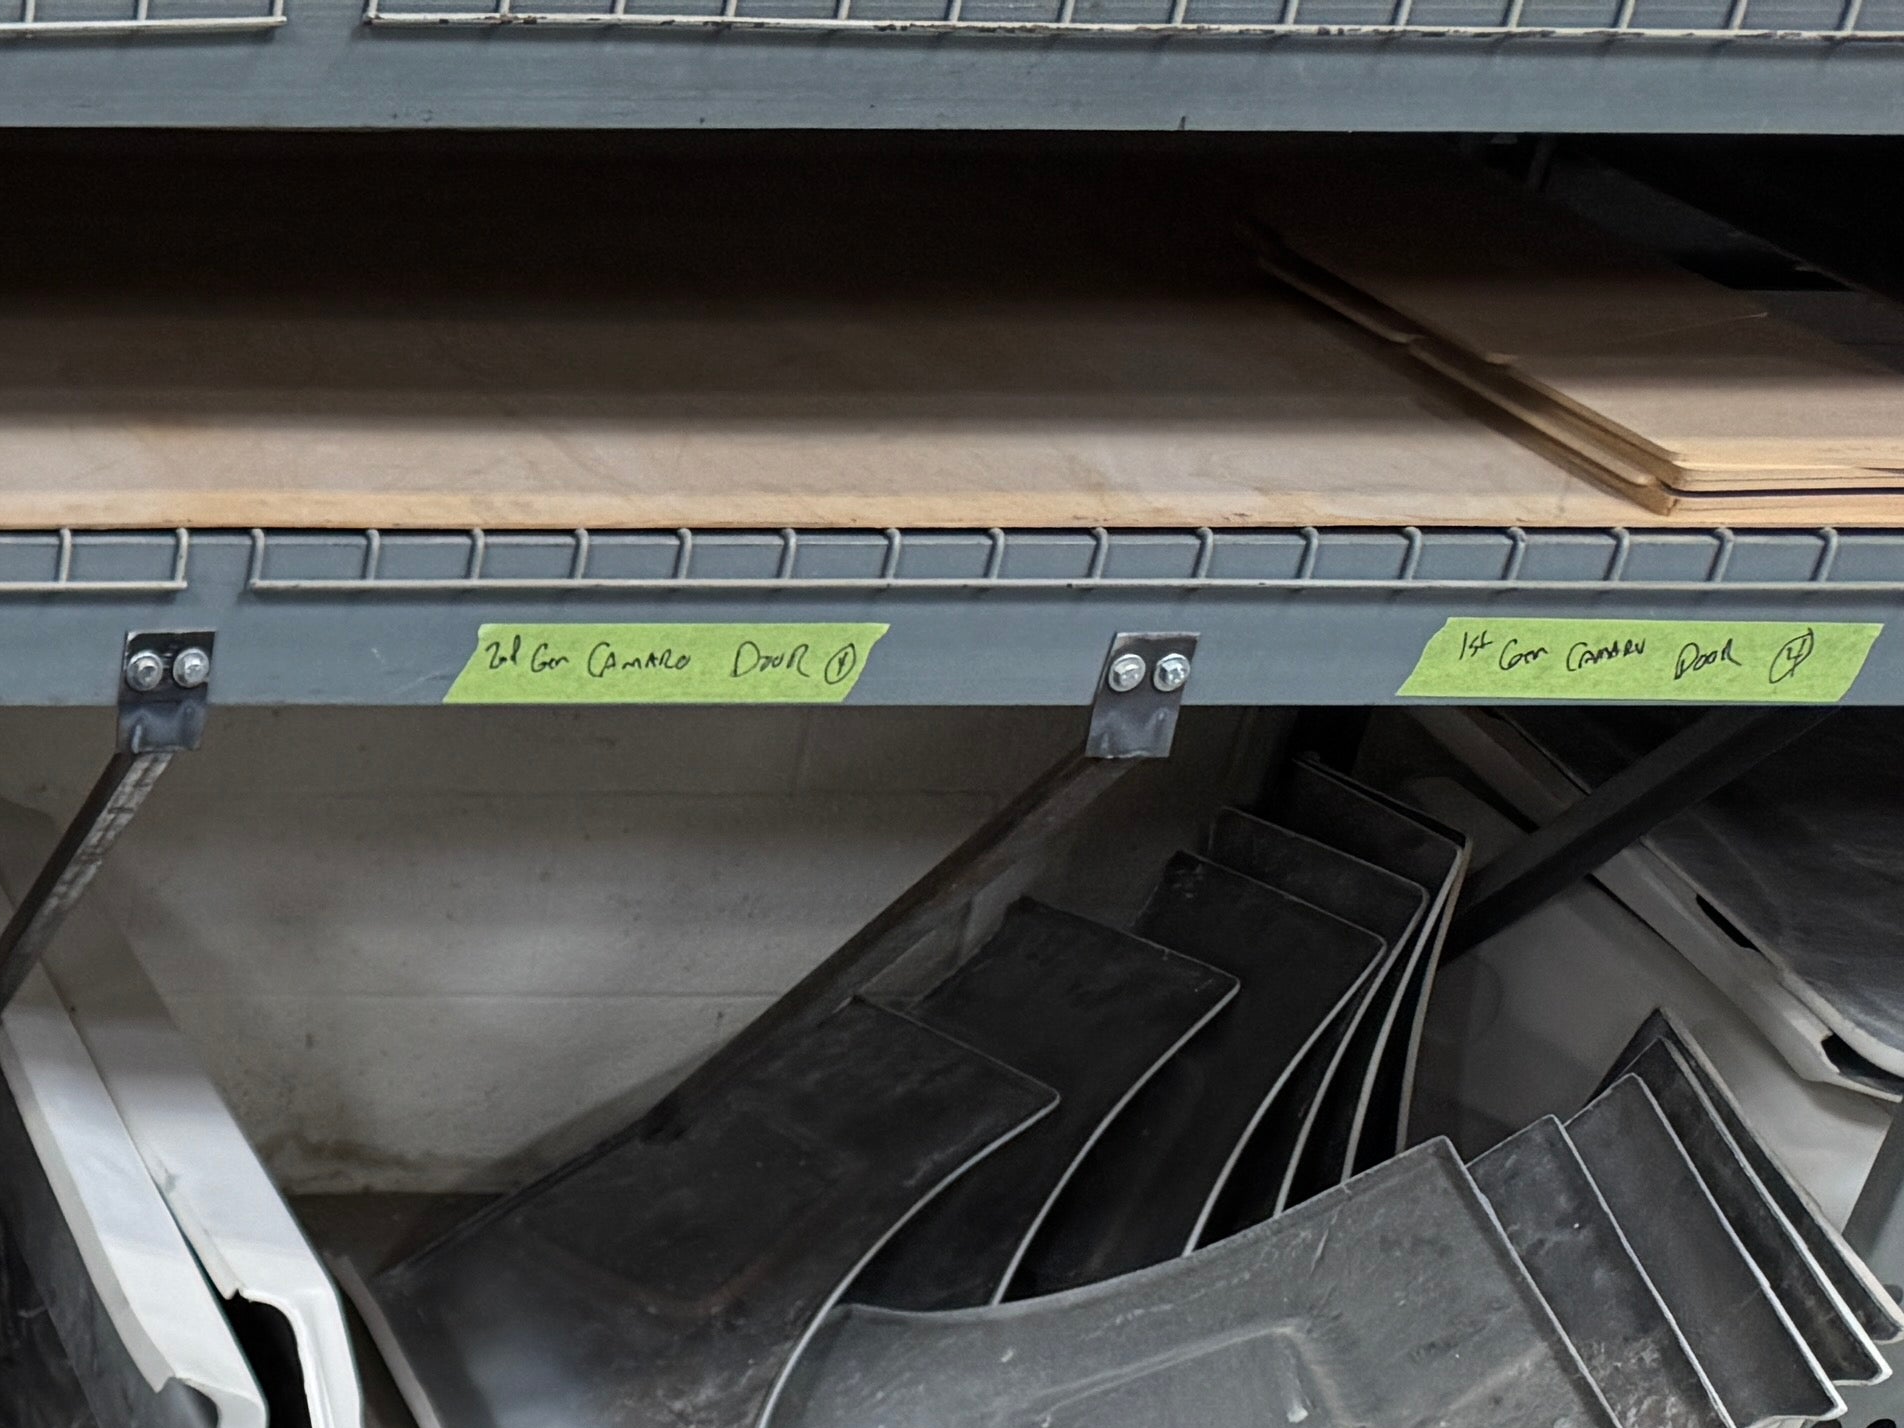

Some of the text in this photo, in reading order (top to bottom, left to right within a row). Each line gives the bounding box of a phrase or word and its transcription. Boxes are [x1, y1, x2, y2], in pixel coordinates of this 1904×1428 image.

[530, 642, 570, 673] Gen
[1458, 630, 1493, 661] 1st
[1498, 638, 1549, 671] Gen
